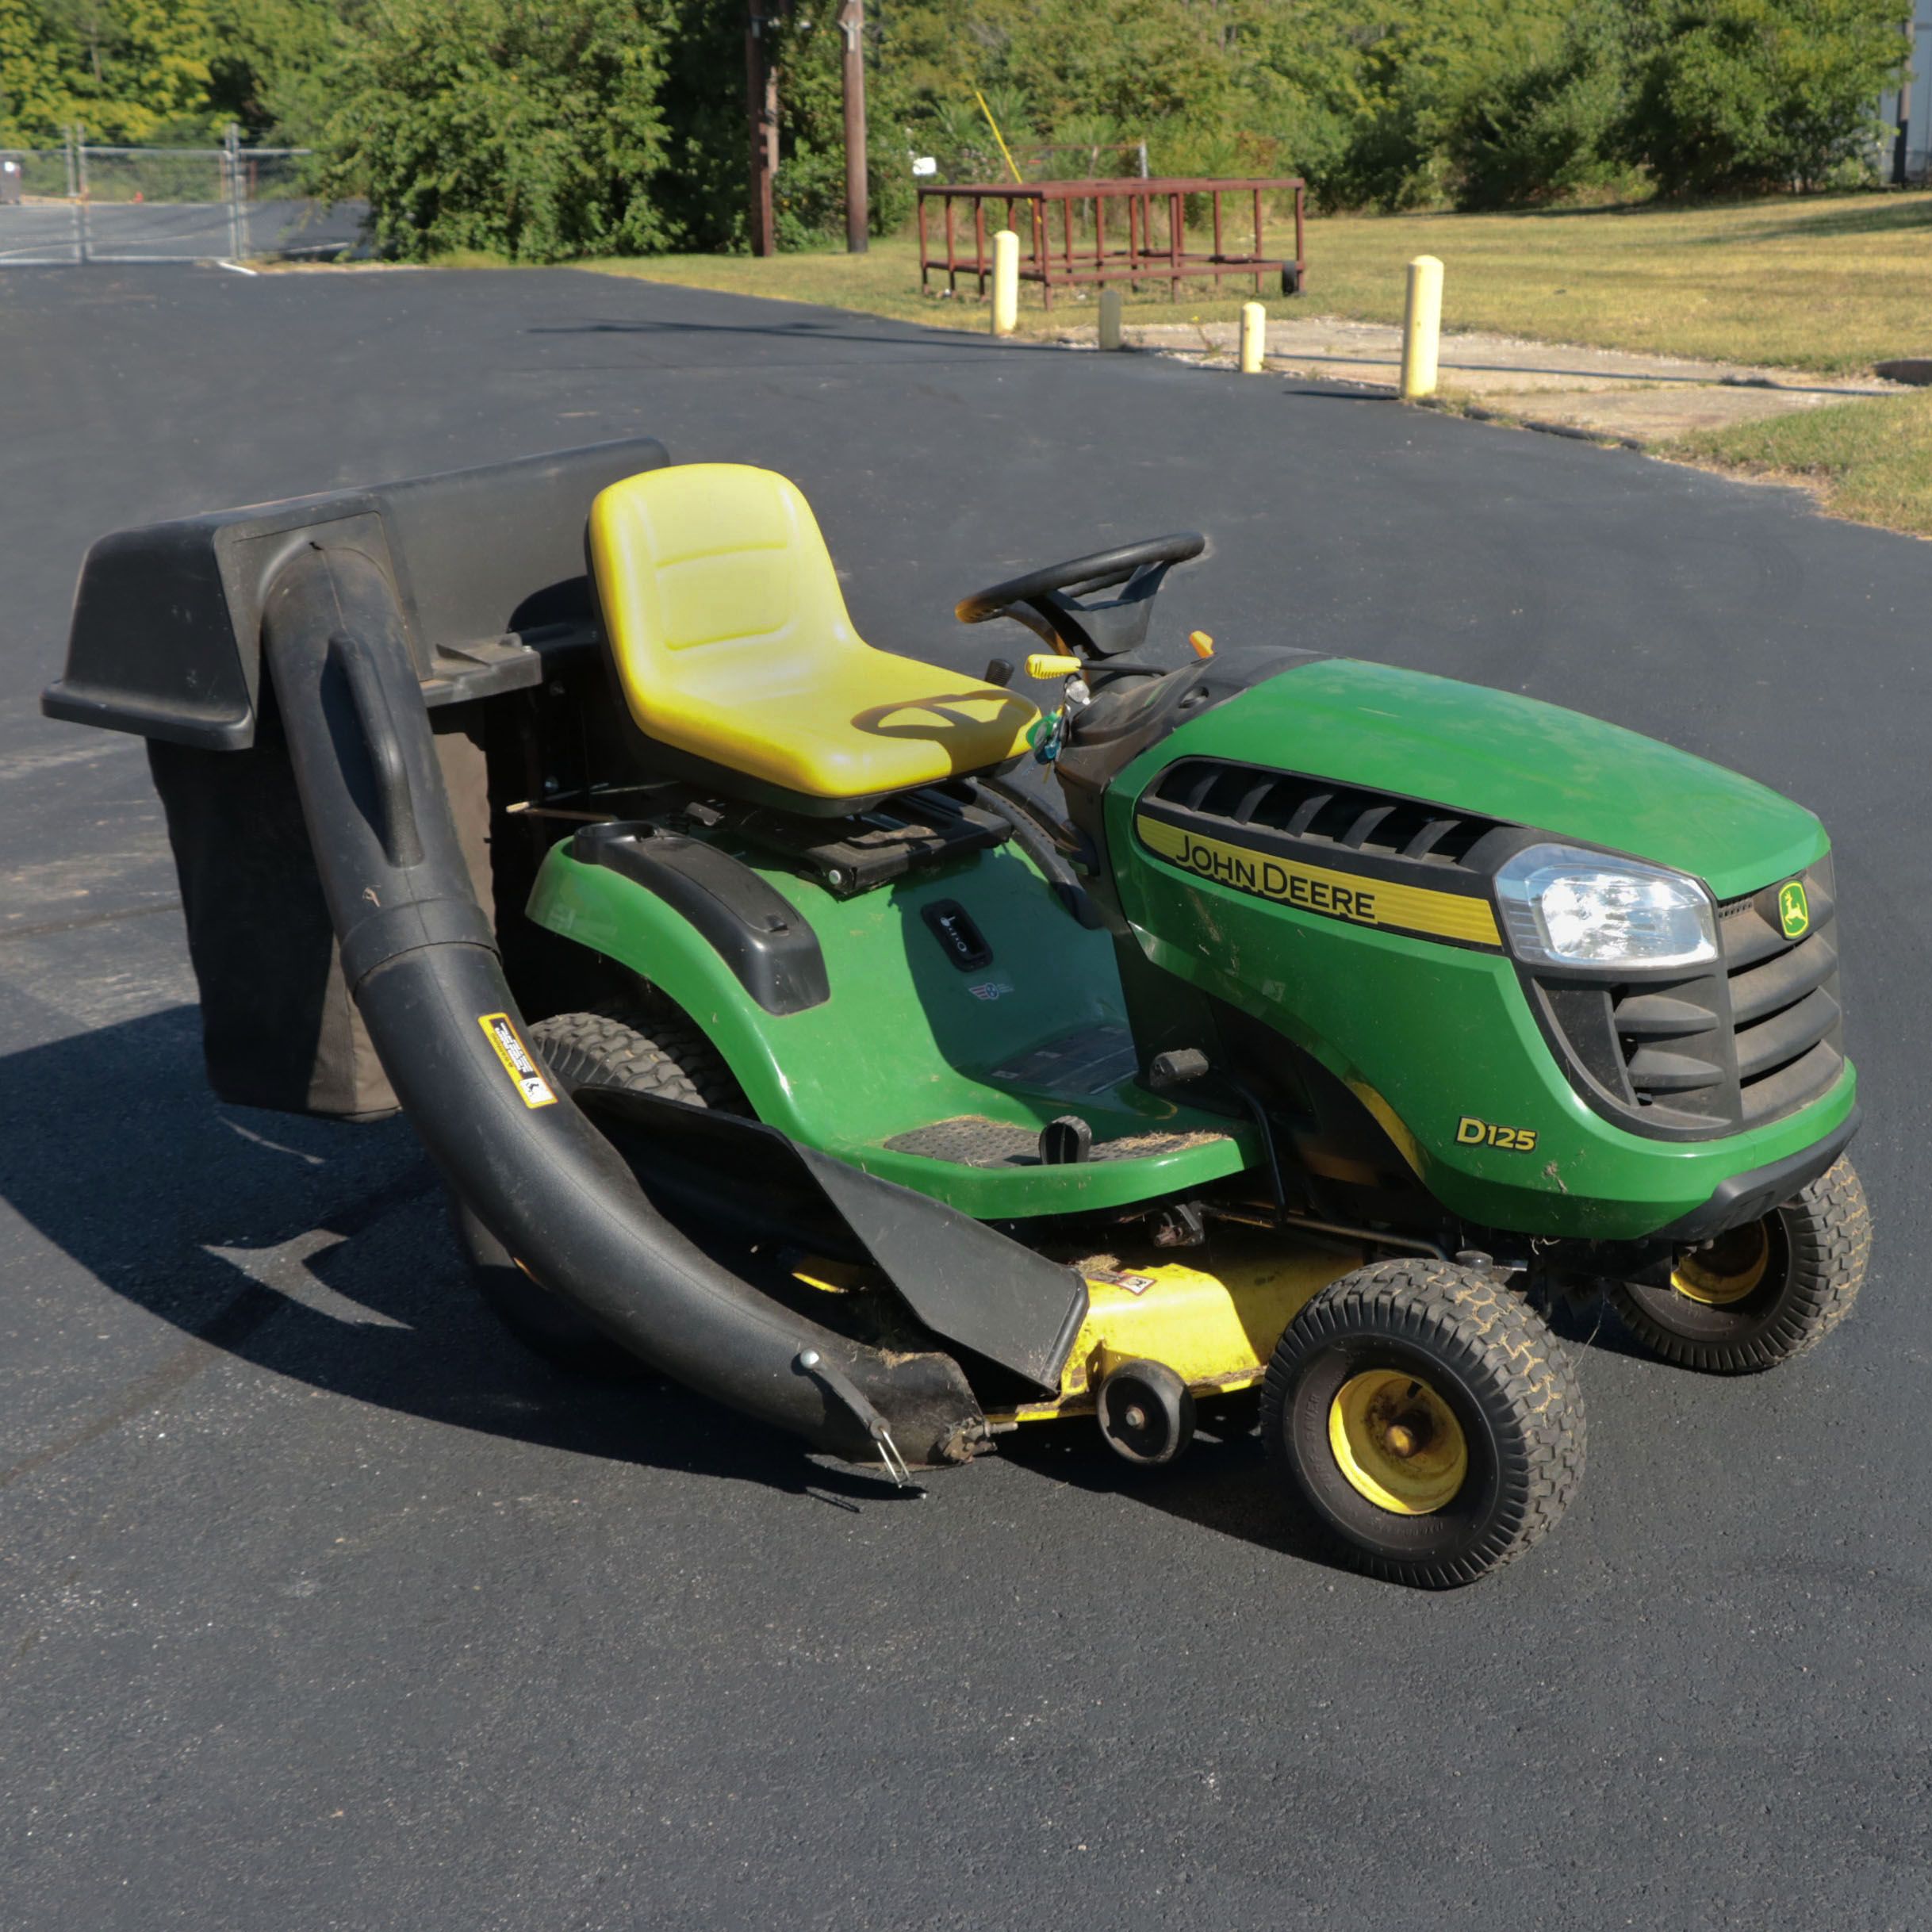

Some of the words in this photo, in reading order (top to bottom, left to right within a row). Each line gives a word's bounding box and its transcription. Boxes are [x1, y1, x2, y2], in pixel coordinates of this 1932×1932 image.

[1175, 834, 1255, 887] JOHN
[1263, 862, 1376, 920] DEERE
[1456, 1116, 1537, 1152] D125
